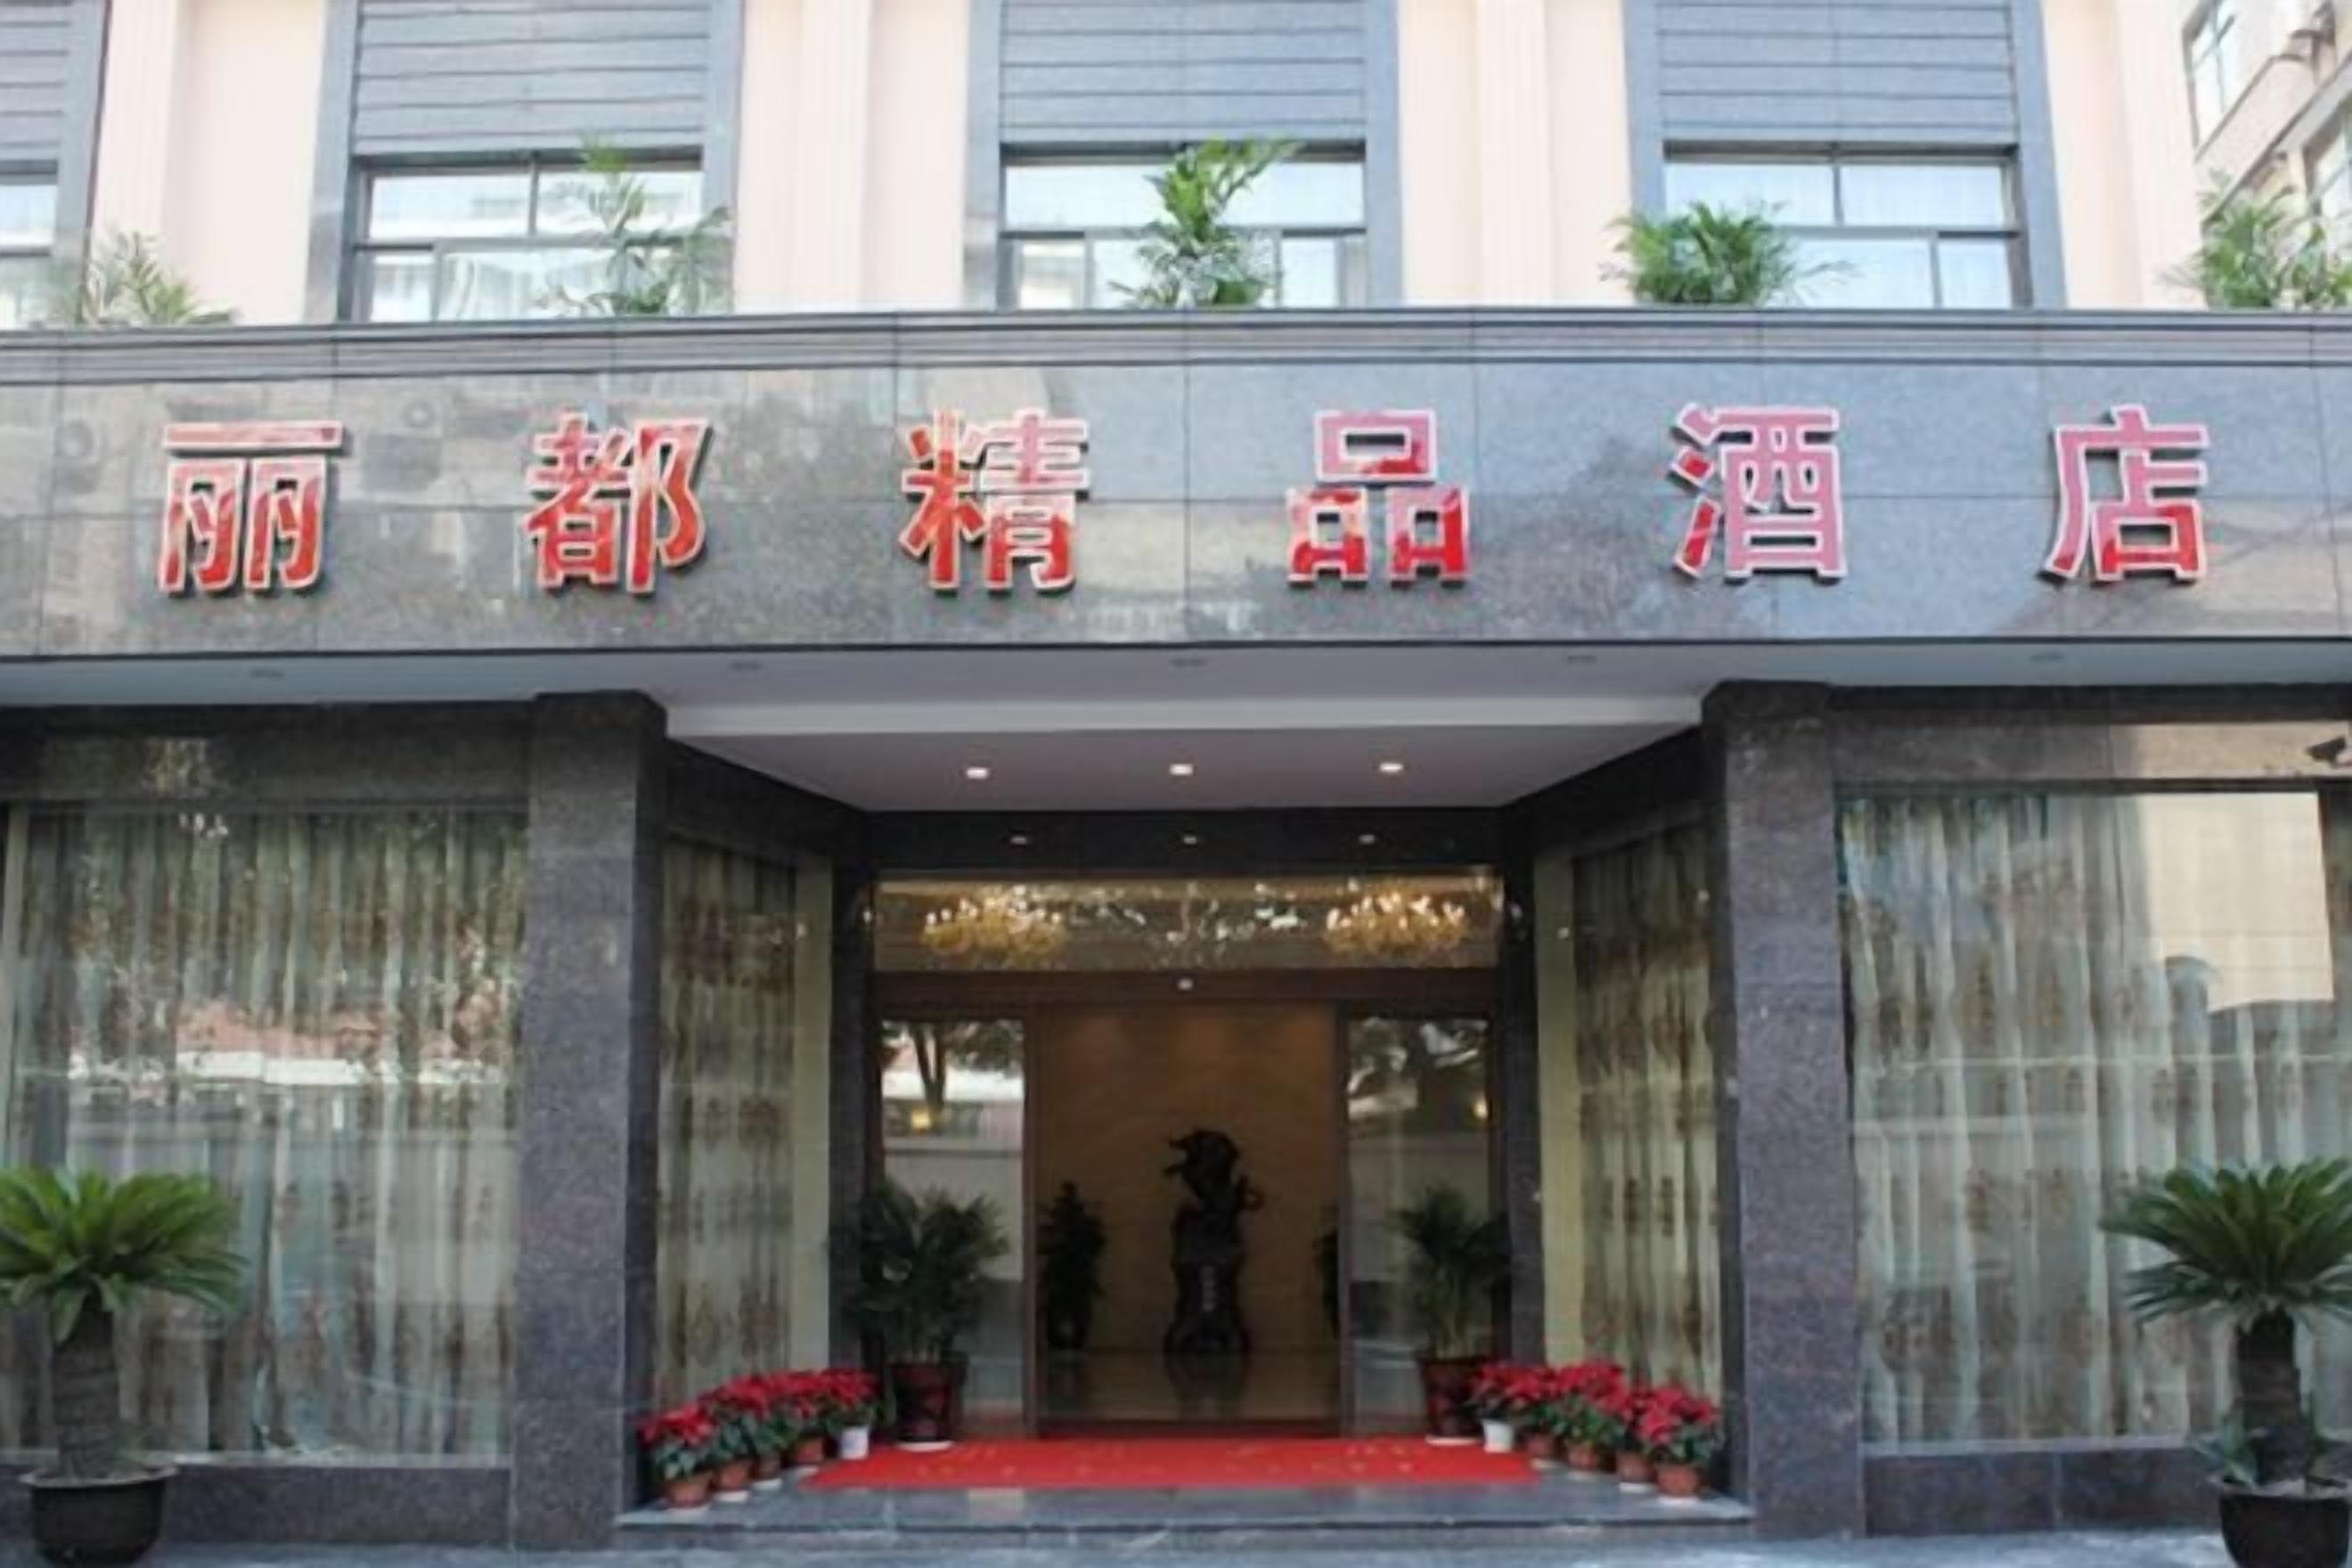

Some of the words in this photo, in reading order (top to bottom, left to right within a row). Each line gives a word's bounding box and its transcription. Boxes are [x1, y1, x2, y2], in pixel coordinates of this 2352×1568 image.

[159, 404, 2210, 594] 丽都精品酒店
